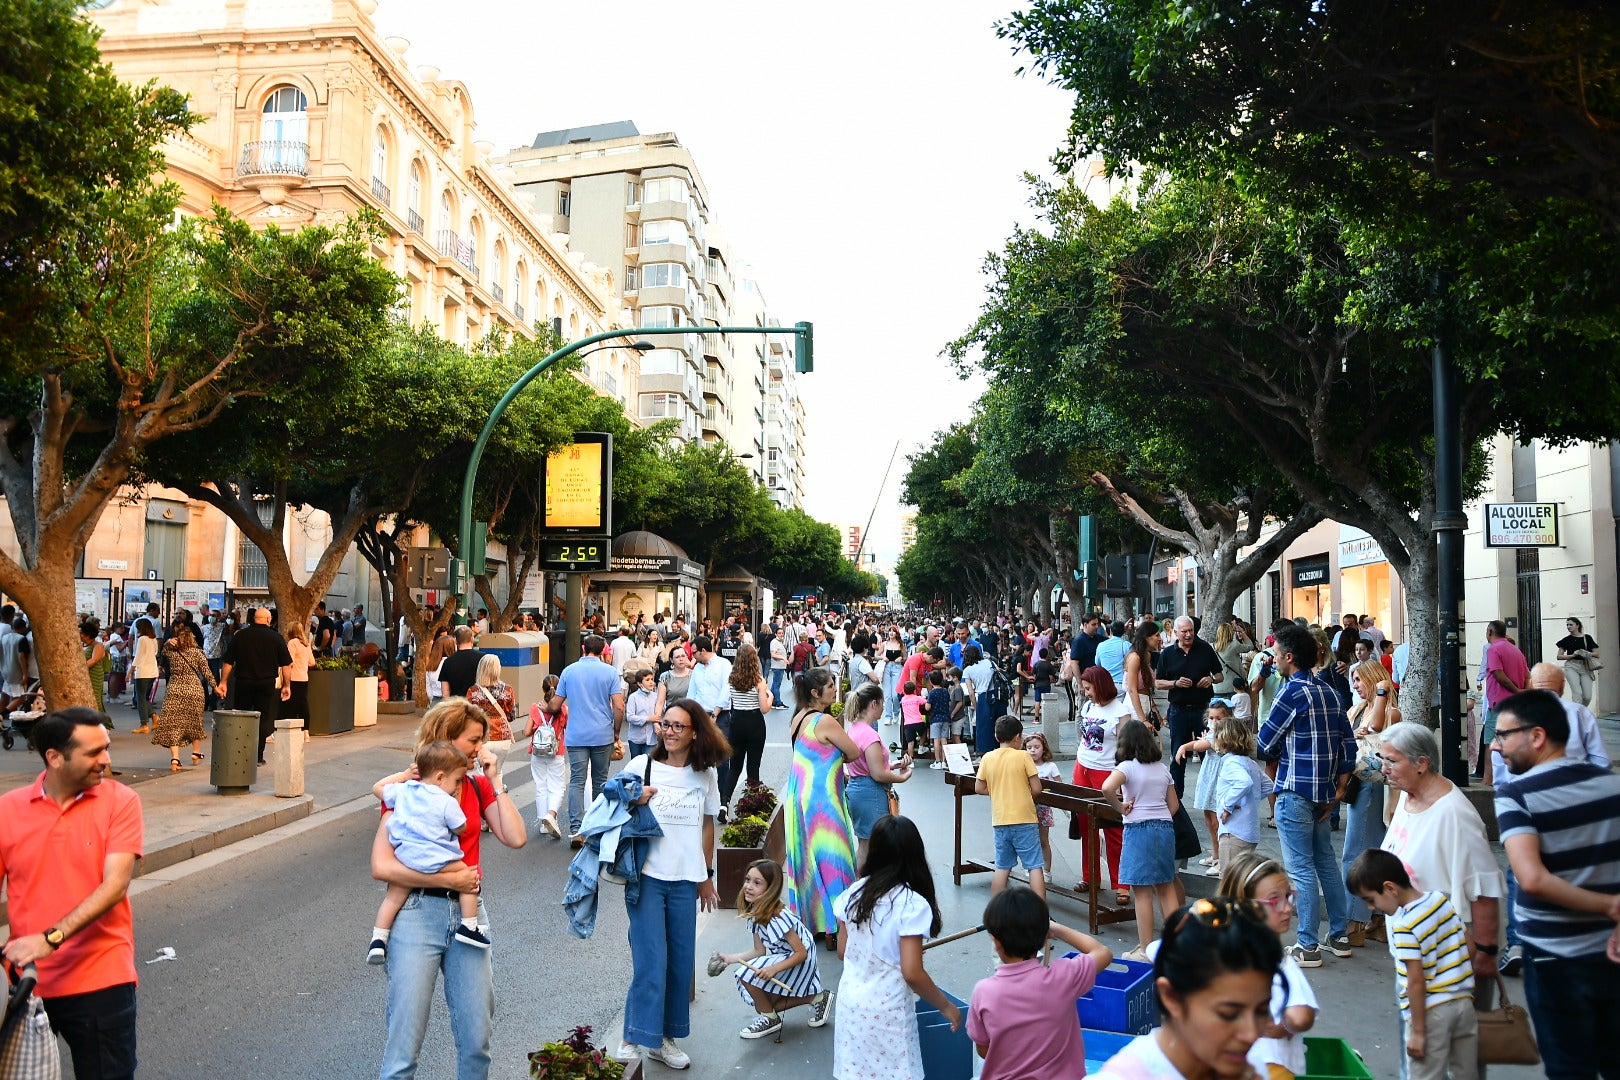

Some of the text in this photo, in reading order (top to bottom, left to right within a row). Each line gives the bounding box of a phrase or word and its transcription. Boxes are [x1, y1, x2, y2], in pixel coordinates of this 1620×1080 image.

[1491, 507, 1552, 518] ALQUILER
[1502, 519, 1546, 529] LOCAL
[1491, 534, 1510, 543] 696
[1535, 534, 1554, 543] 900
